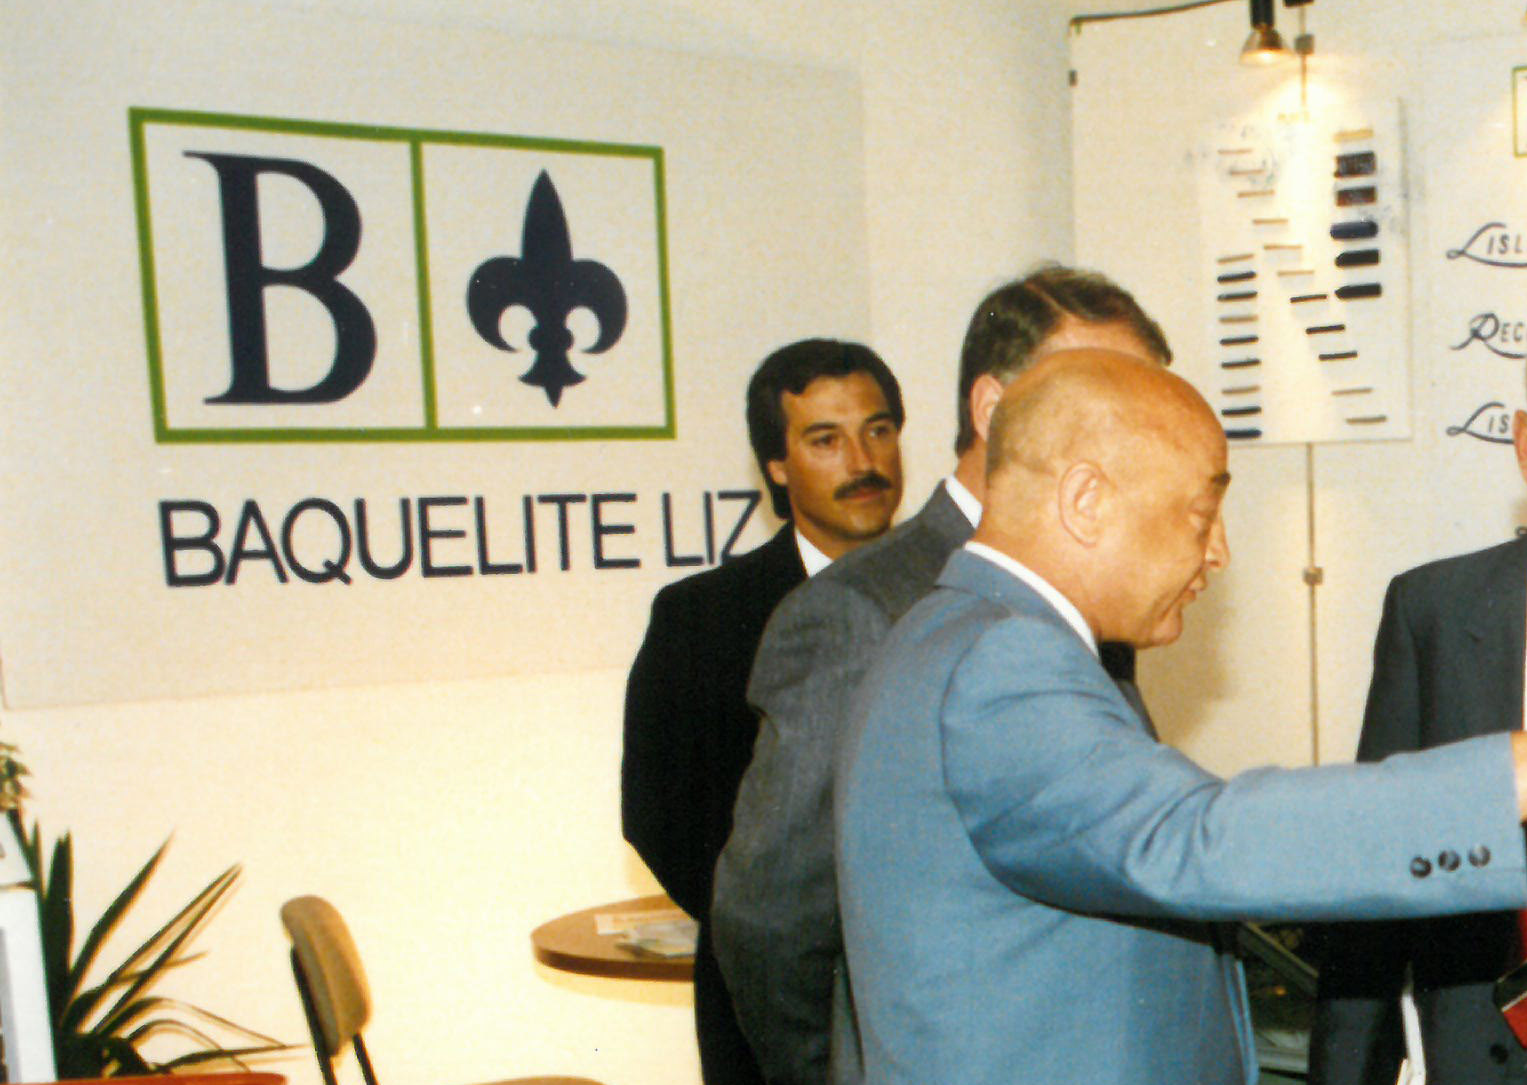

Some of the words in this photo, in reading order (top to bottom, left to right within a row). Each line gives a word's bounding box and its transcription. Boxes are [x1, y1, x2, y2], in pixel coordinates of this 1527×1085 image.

[181, 150, 378, 406] B
[1446, 401, 1513, 440] LIS
[157, 491, 642, 586] BAQUELITE
[662, 489, 762, 567] LIZ
